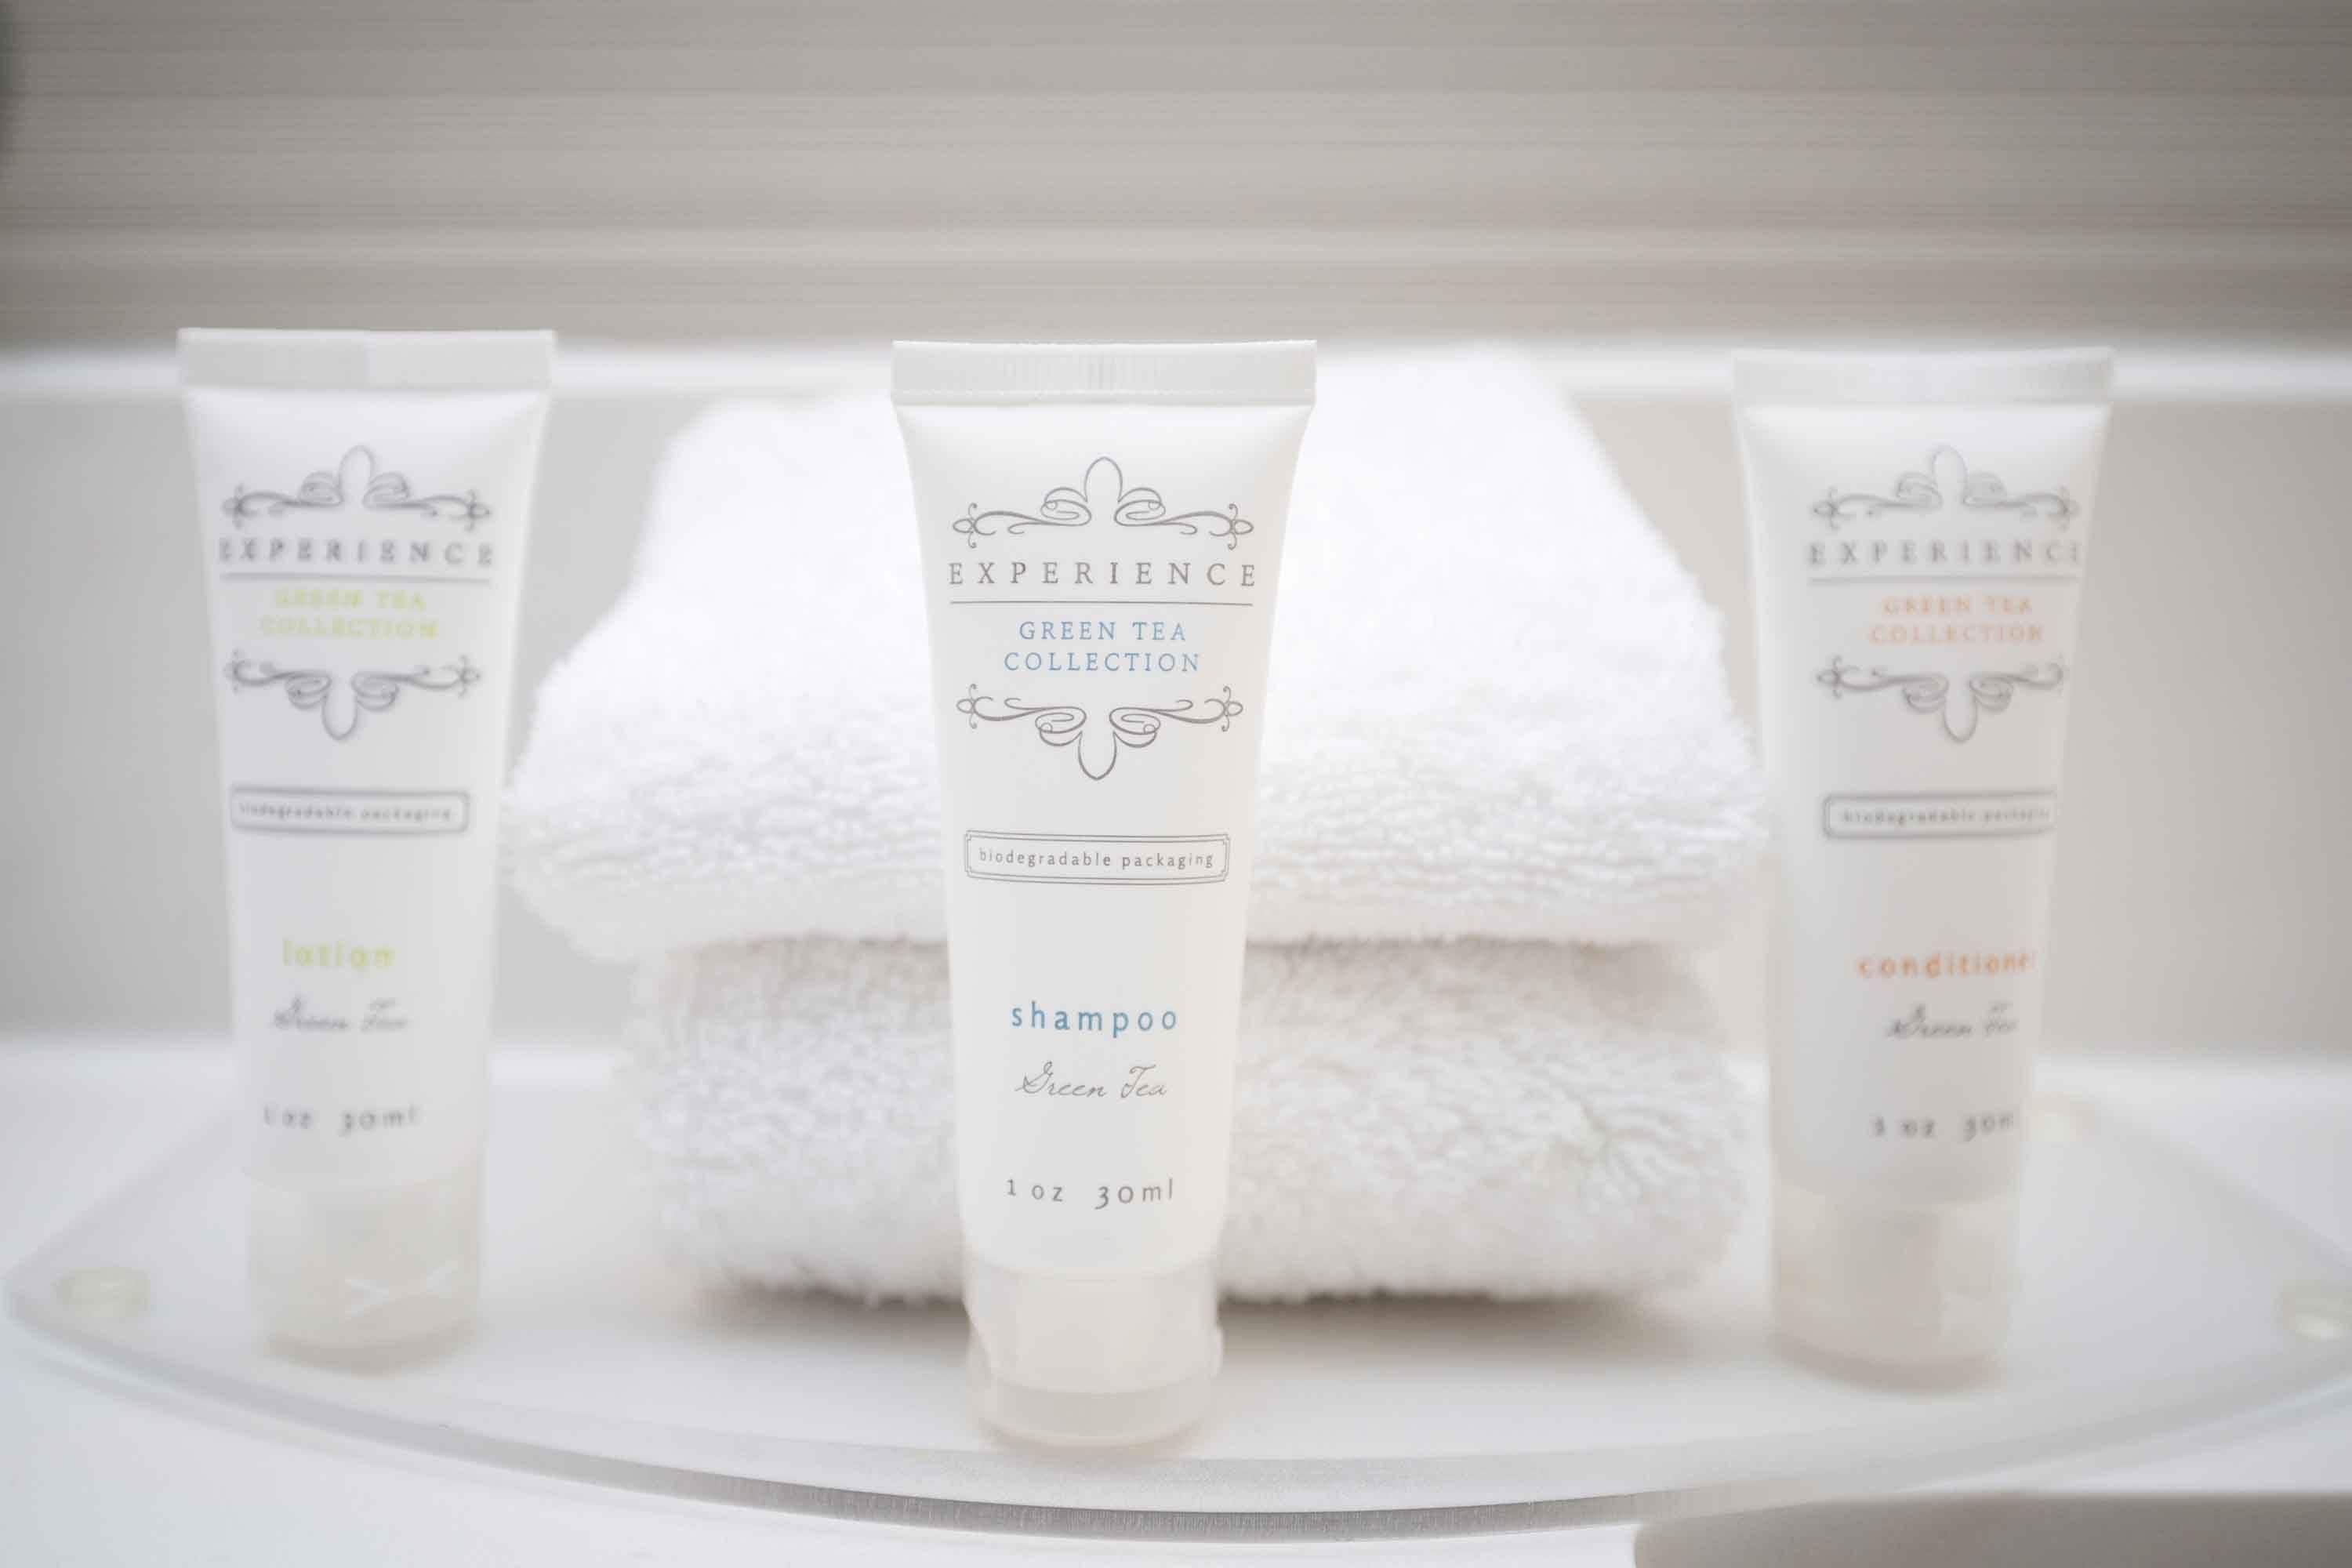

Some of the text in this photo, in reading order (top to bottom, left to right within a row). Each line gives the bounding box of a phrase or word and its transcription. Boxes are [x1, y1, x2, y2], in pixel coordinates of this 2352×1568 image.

[219, 536, 493, 565] EXPERIENCE
[948, 561, 1255, 587] EXPERIENCE
[274, 590, 426, 613] GREEN TEA
[1882, 595, 2034, 616] GREEN TEA
[260, 615, 439, 640] COLLECTION
[1019, 621, 1187, 641] GREEN TEA
[1868, 623, 2044, 645] COLLECTION
[1004, 652, 1200, 673] COLLECTION
[978, 847, 1214, 870] biodegradable packaging
[281, 938, 395, 971] lotion
[1857, 949, 2037, 978] conditione
[1011, 1000, 1178, 1039] shampoo
[1014, 1060, 1168, 1099] Green Tea
[1961, 1111, 2016, 1142] 30m
[1007, 1178, 1174, 1210] 1 oz 30ml
